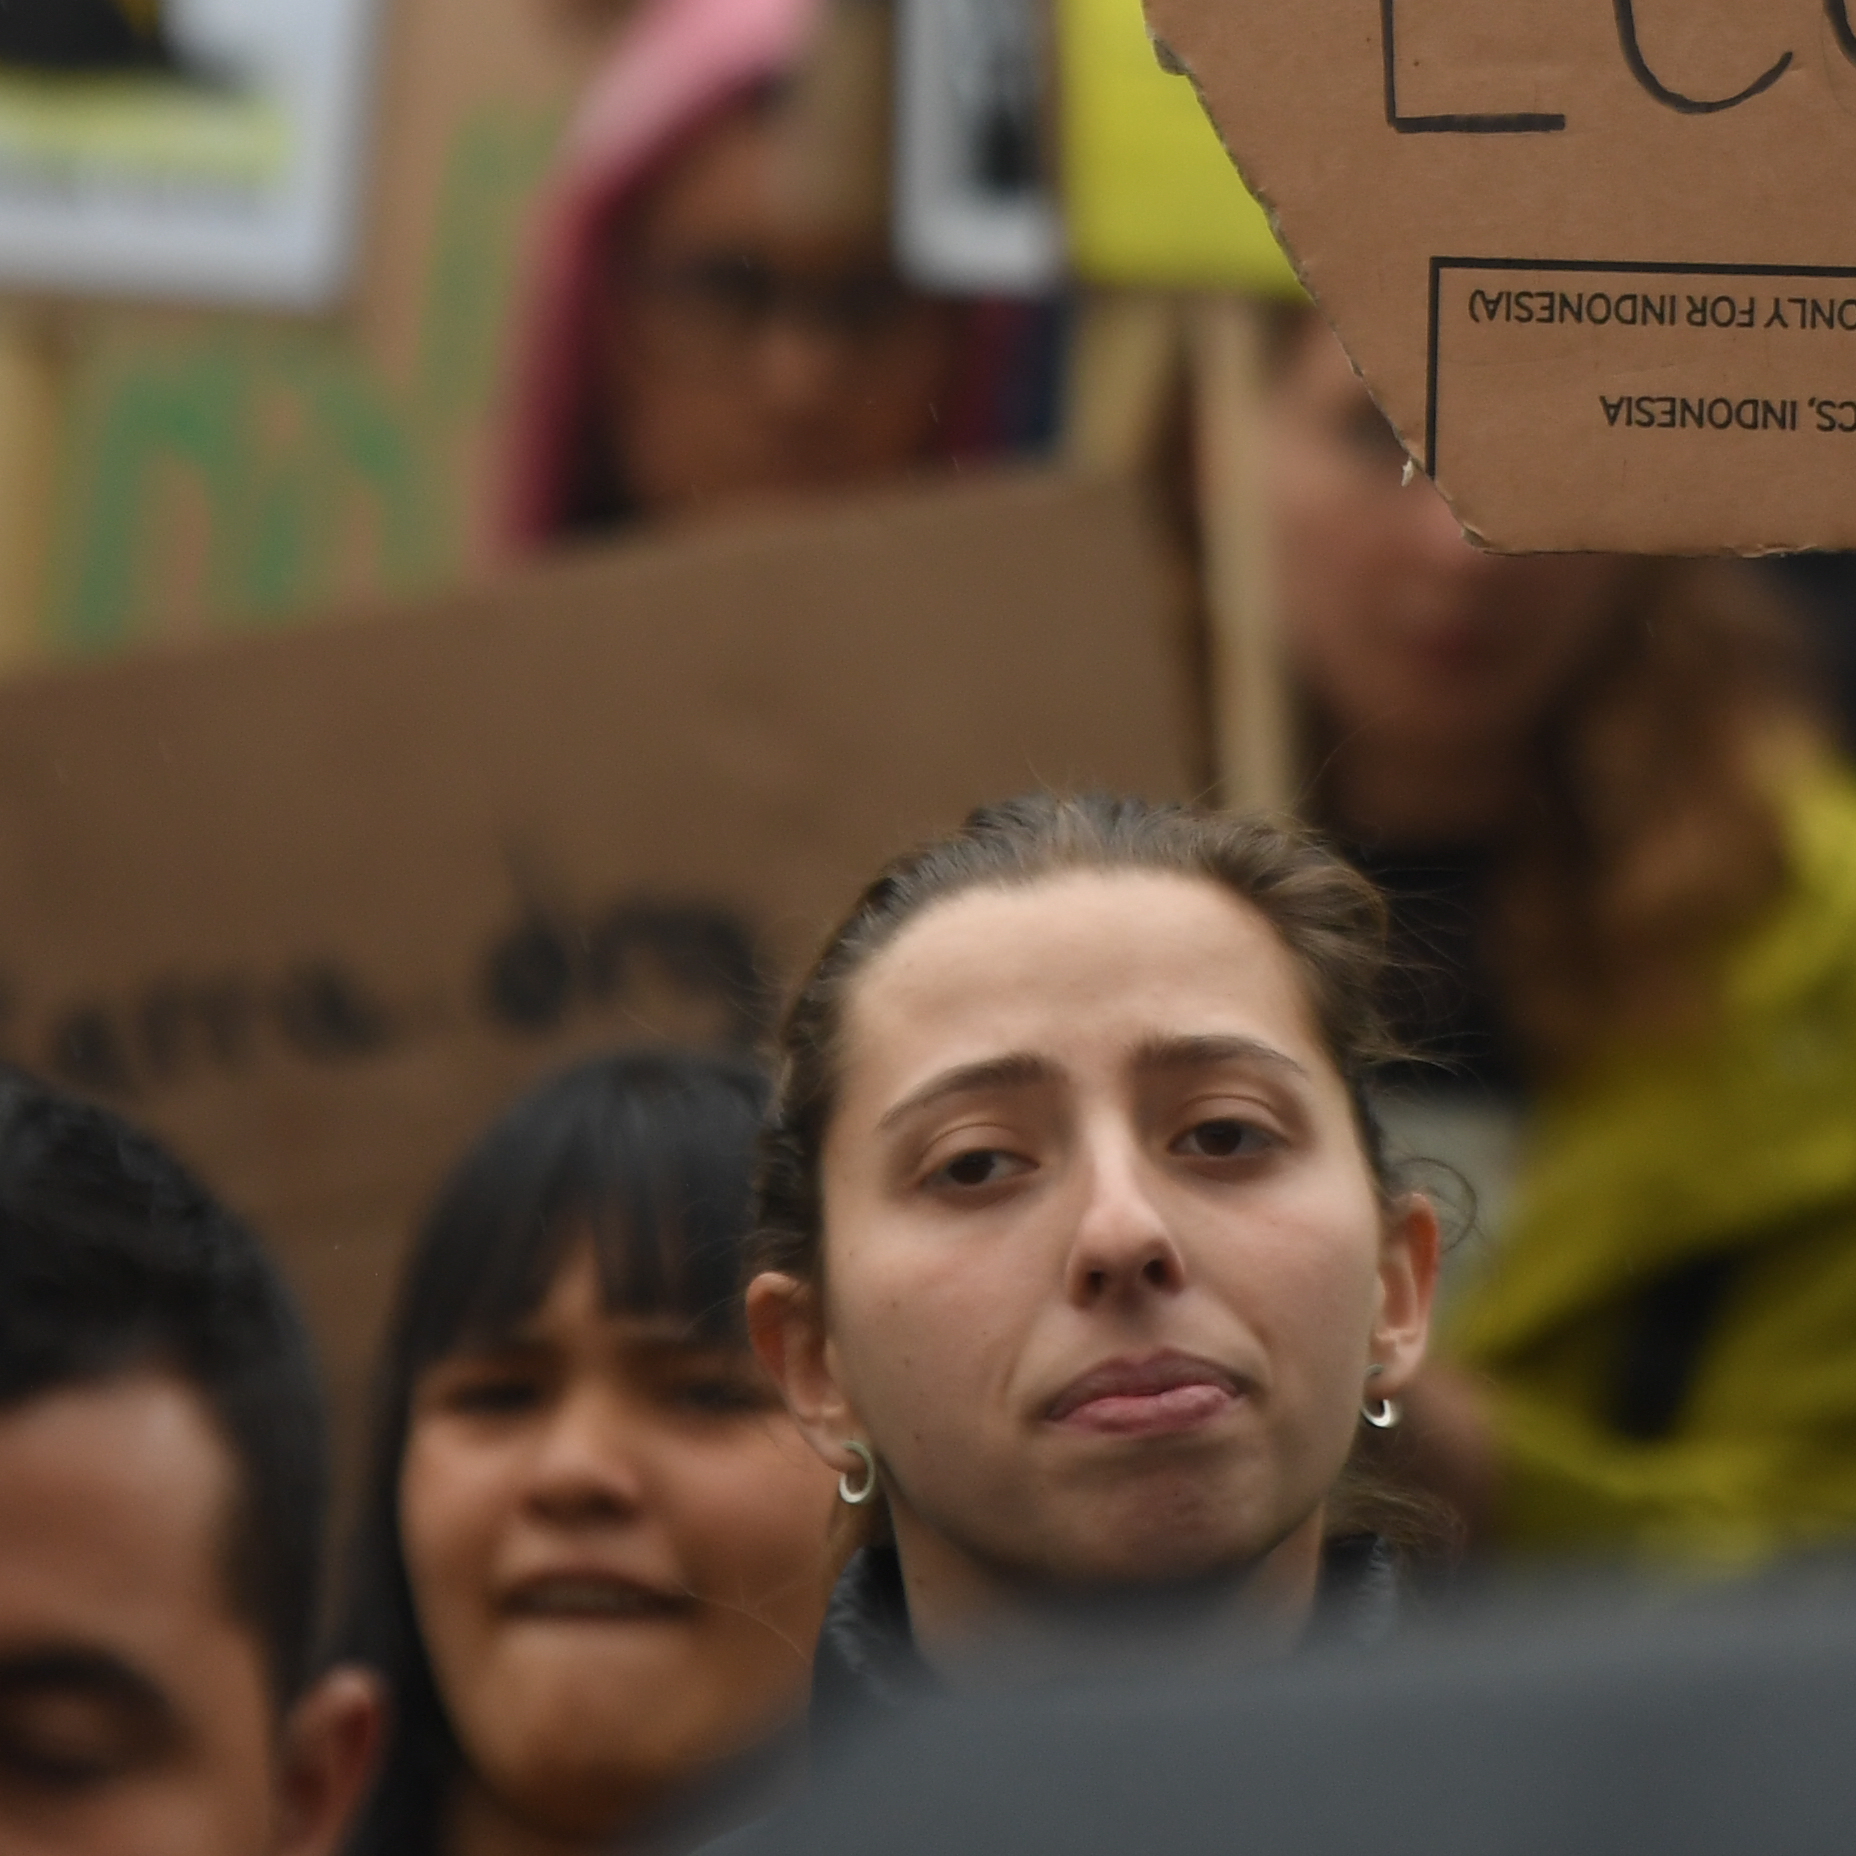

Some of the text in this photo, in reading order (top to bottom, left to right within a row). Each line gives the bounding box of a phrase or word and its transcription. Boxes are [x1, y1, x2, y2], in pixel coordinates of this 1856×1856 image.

[1468, 289, 1676, 325] INDONESIA)
[1687, 295, 1755, 328] FOR
[1599, 396, 1798, 430] INDONESIA
